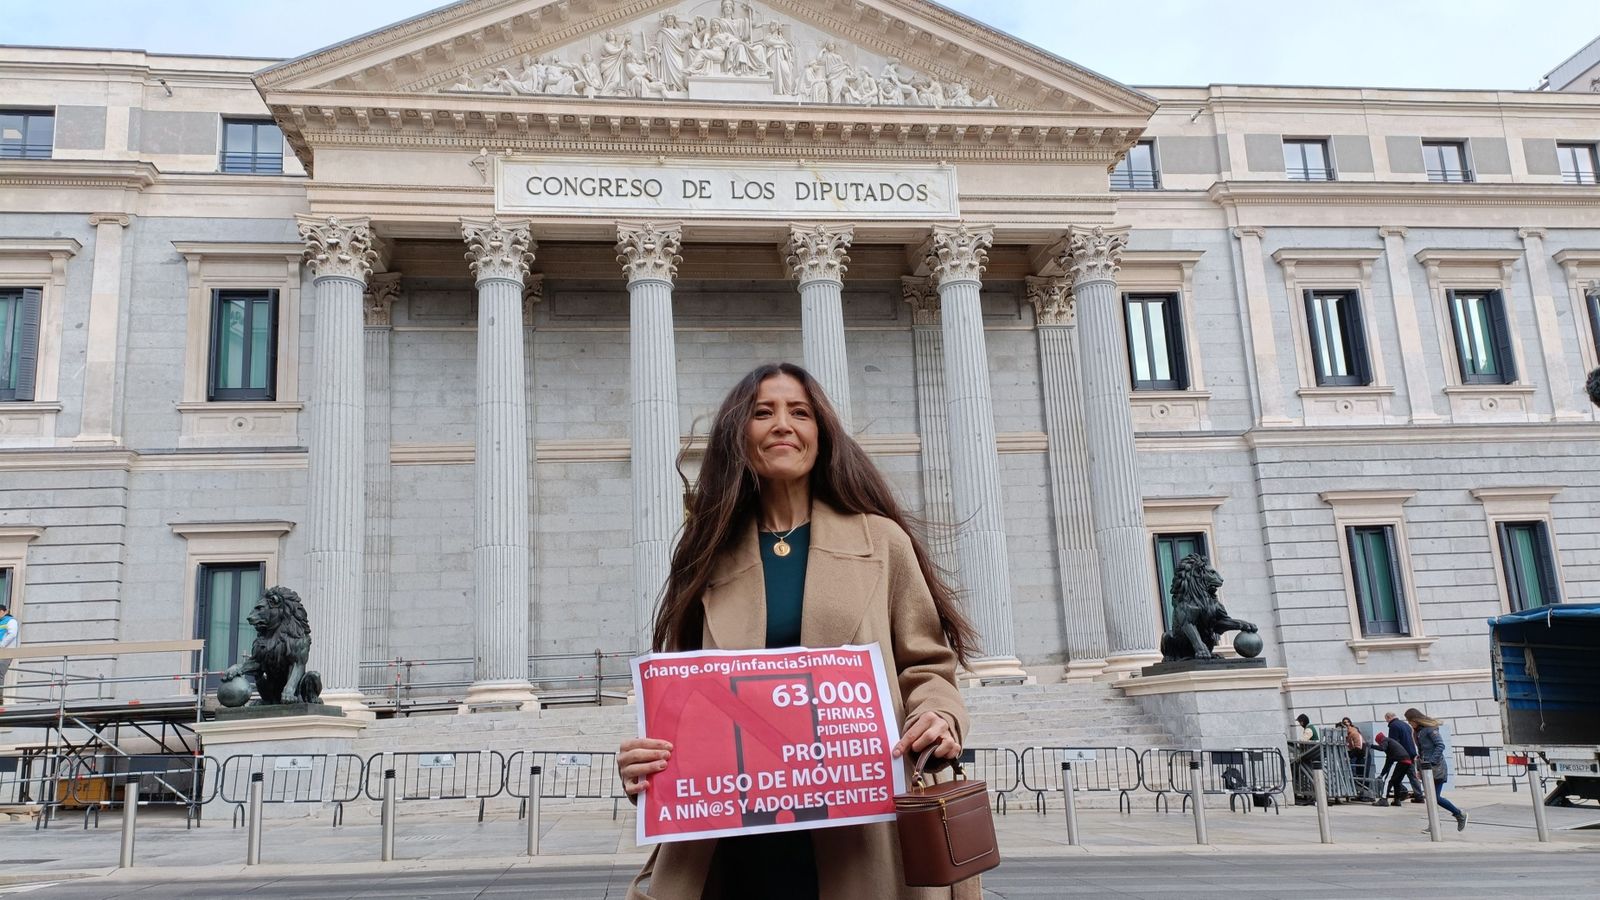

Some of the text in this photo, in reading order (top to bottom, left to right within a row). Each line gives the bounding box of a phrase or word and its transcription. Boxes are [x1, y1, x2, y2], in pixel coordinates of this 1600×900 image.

[526, 175, 928, 202] CONGRESO DE LOS DIPUTADOS
[644, 654, 862, 680] change.org/infanciaSinMovil
[771, 682, 872, 707] 63.000
[818, 707, 875, 721] FIRMAS
[816, 722, 878, 736] PIDIENDO
[782, 738, 883, 762] PROHIBIR
[676, 762, 886, 798] EL USO DE MÓVILES
[659, 787, 888, 822] A NIÑ@S Y ADOLESCENTES
